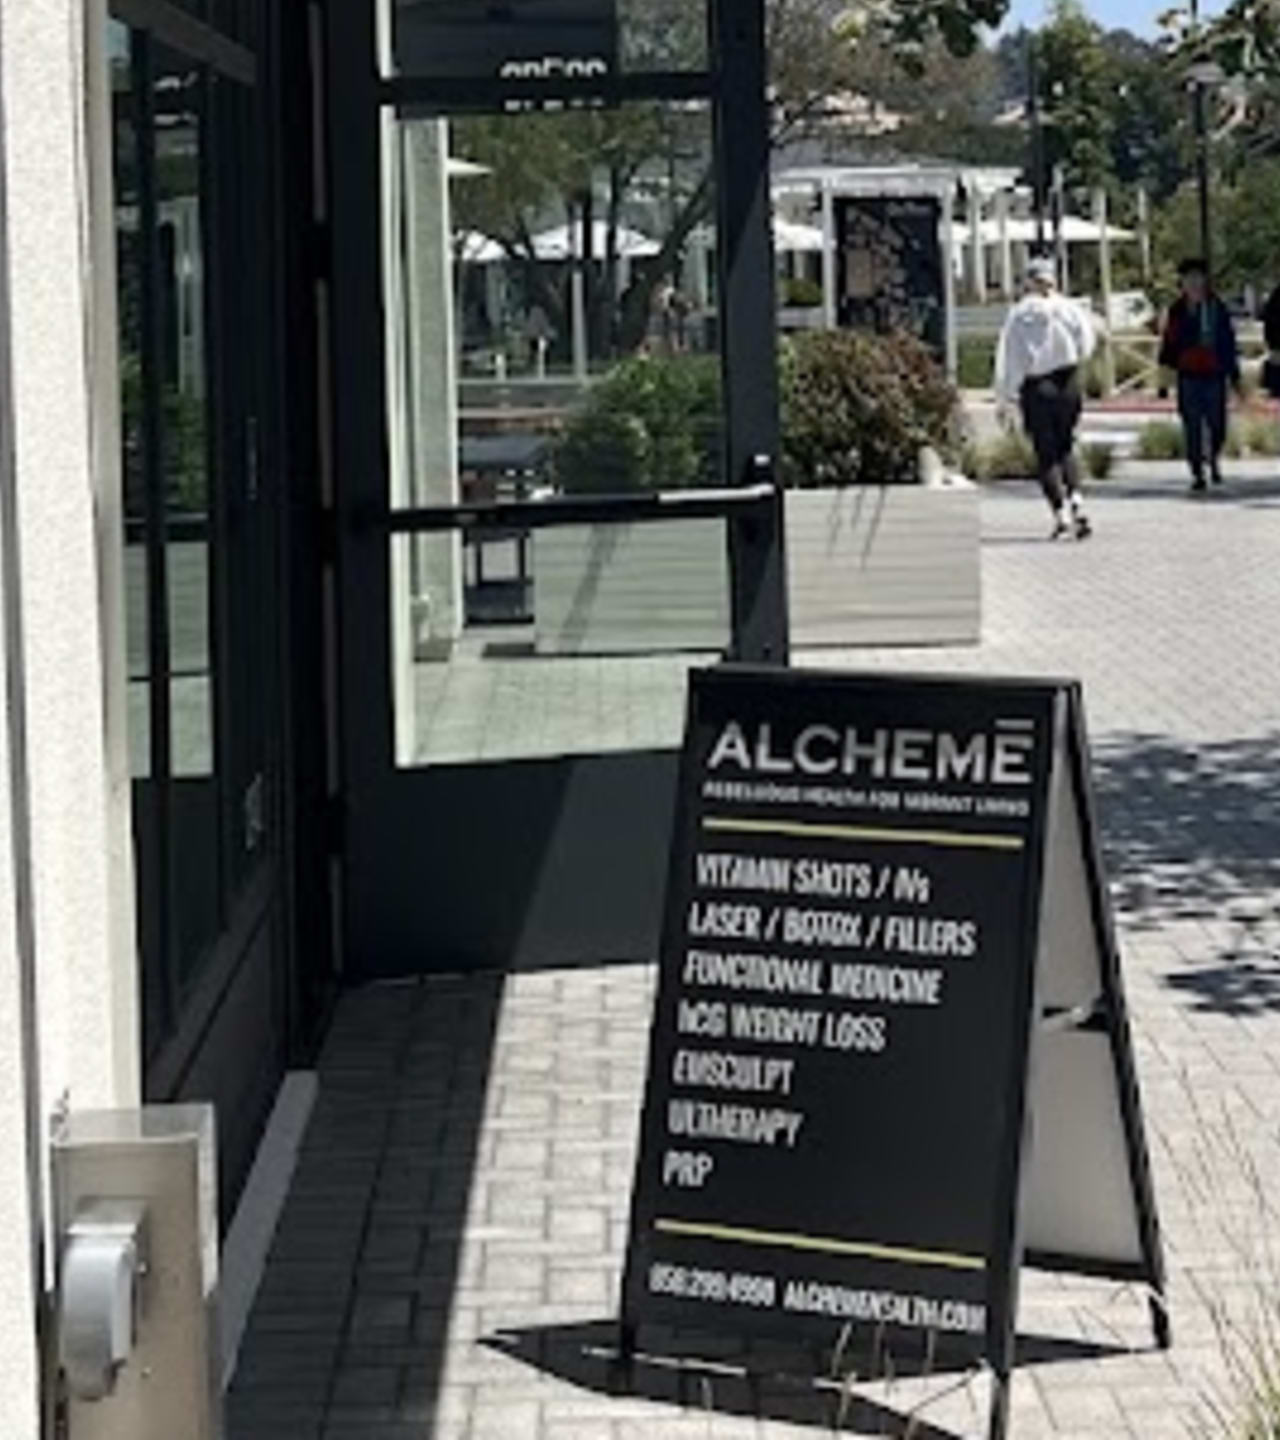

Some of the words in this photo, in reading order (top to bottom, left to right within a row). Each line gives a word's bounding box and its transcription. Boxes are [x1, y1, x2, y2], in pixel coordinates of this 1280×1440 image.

[697, 853, 790, 891] VITAMIN
[793, 860, 871, 898] SHOTS
[688, 901, 761, 940] LASER
[783, 908, 862, 947] BOTOX
[884, 917, 977, 956] FILLERS
[683, 950, 823, 995] FUNCTIONAL
[829, 963, 943, 1005] MEDICINE
[730, 1003, 823, 1046] WEIGHT
[823, 1013, 887, 1051] LOSS
[668, 1099, 804, 1147] ULTHERAPY
[662, 1149, 714, 1187] PRP
